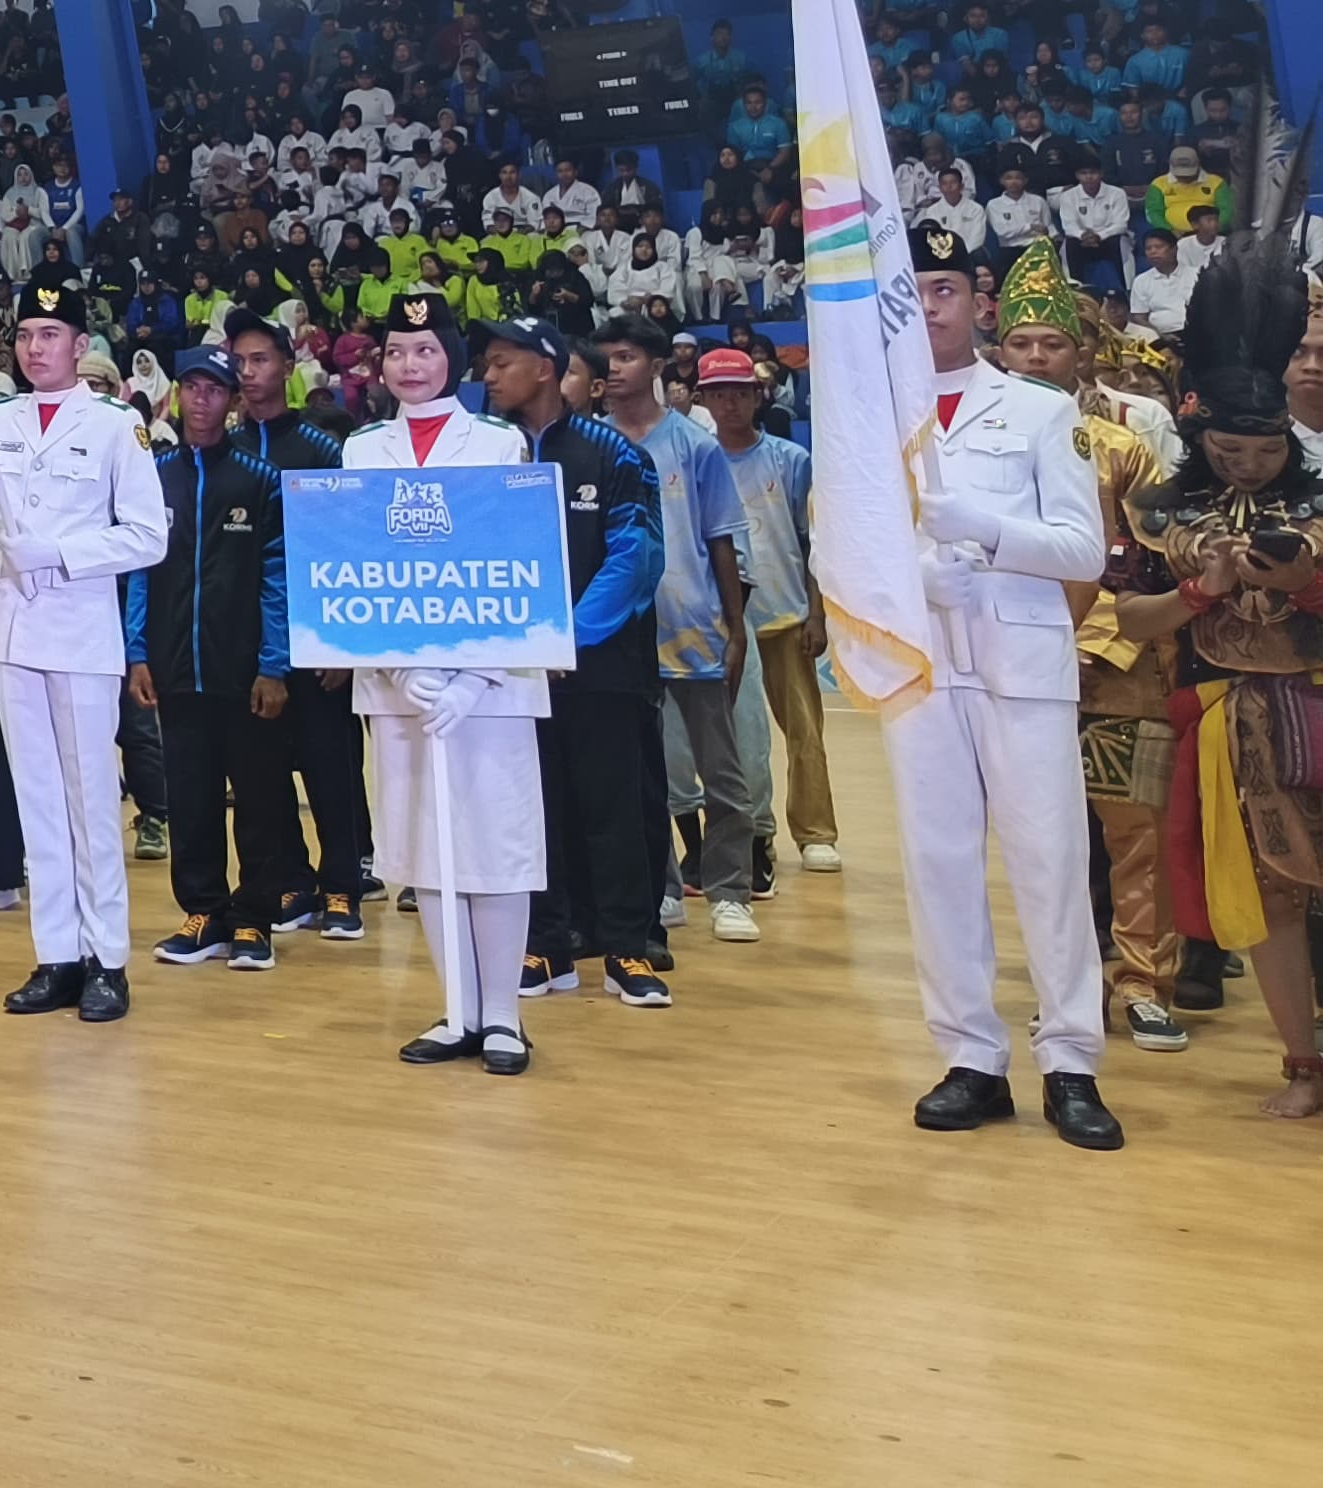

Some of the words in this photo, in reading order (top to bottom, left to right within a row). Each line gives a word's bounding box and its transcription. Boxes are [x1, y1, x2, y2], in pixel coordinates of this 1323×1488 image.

[390, 508, 447, 530] FORDA
[412, 522, 428, 531] VII
[310, 560, 540, 589] KABUPATEN
[321, 596, 530, 625] KOTABARU
